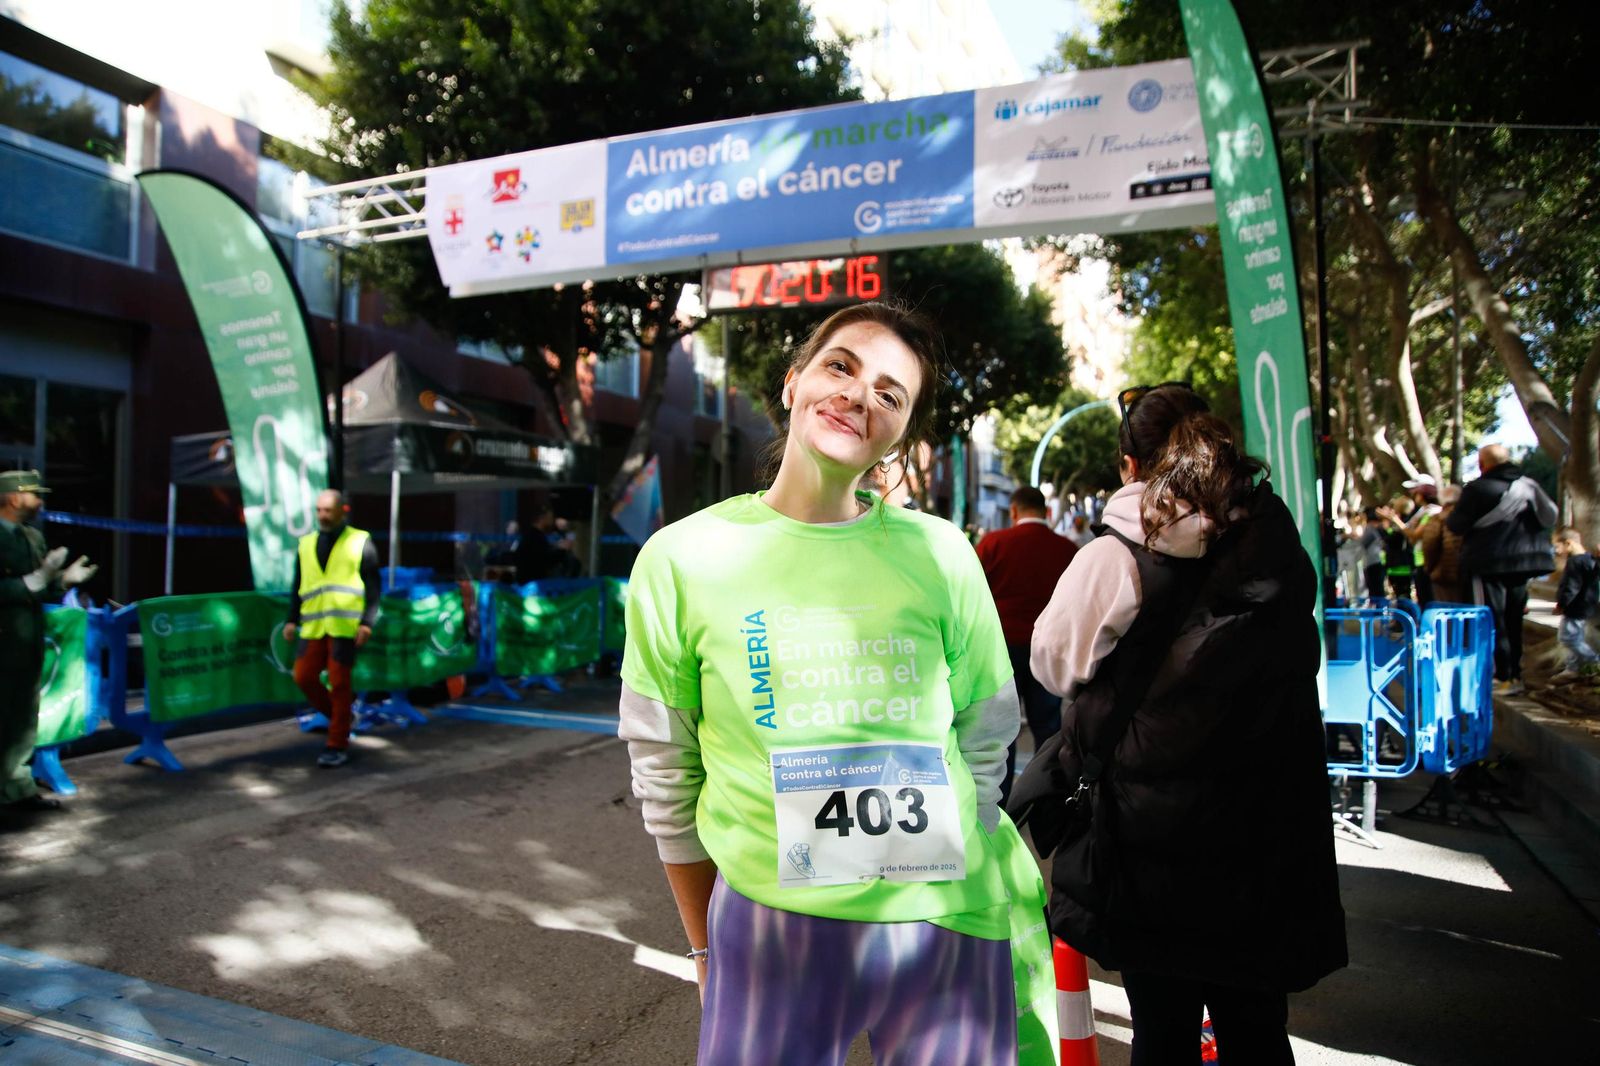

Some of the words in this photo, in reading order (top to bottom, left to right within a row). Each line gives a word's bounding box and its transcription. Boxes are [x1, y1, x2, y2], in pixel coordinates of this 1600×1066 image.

[1024, 93, 1103, 116] cajamar
[626, 133, 750, 178] Almería
[812, 111, 949, 149] marcha
[1100, 131, 1192, 154] Fundación
[1148, 157, 1179, 174] Ejido
[626, 178, 728, 216] contra
[737, 168, 769, 201] el
[779, 158, 902, 194] cáncer
[1031, 183, 1069, 194] Toyota
[1078, 191, 1111, 203] Motor
[777, 638, 813, 661] En
[818, 633, 917, 658] marcha
[740, 609, 778, 730] ALMERÍA
[781, 662, 886, 689] contra
[893, 658, 921, 684] el
[785, 692, 922, 728] cáncer
[780, 754, 828, 768] Almería
[781, 769, 822, 780] contra
[826, 767, 837, 777] el
[840, 764, 883, 776] cáncer
[814, 787, 929, 837] 403
[886, 863, 897, 872] de
[898, 863, 928, 872] febrero
[929, 863, 939, 872] de
[940, 863, 957, 871] 2025
